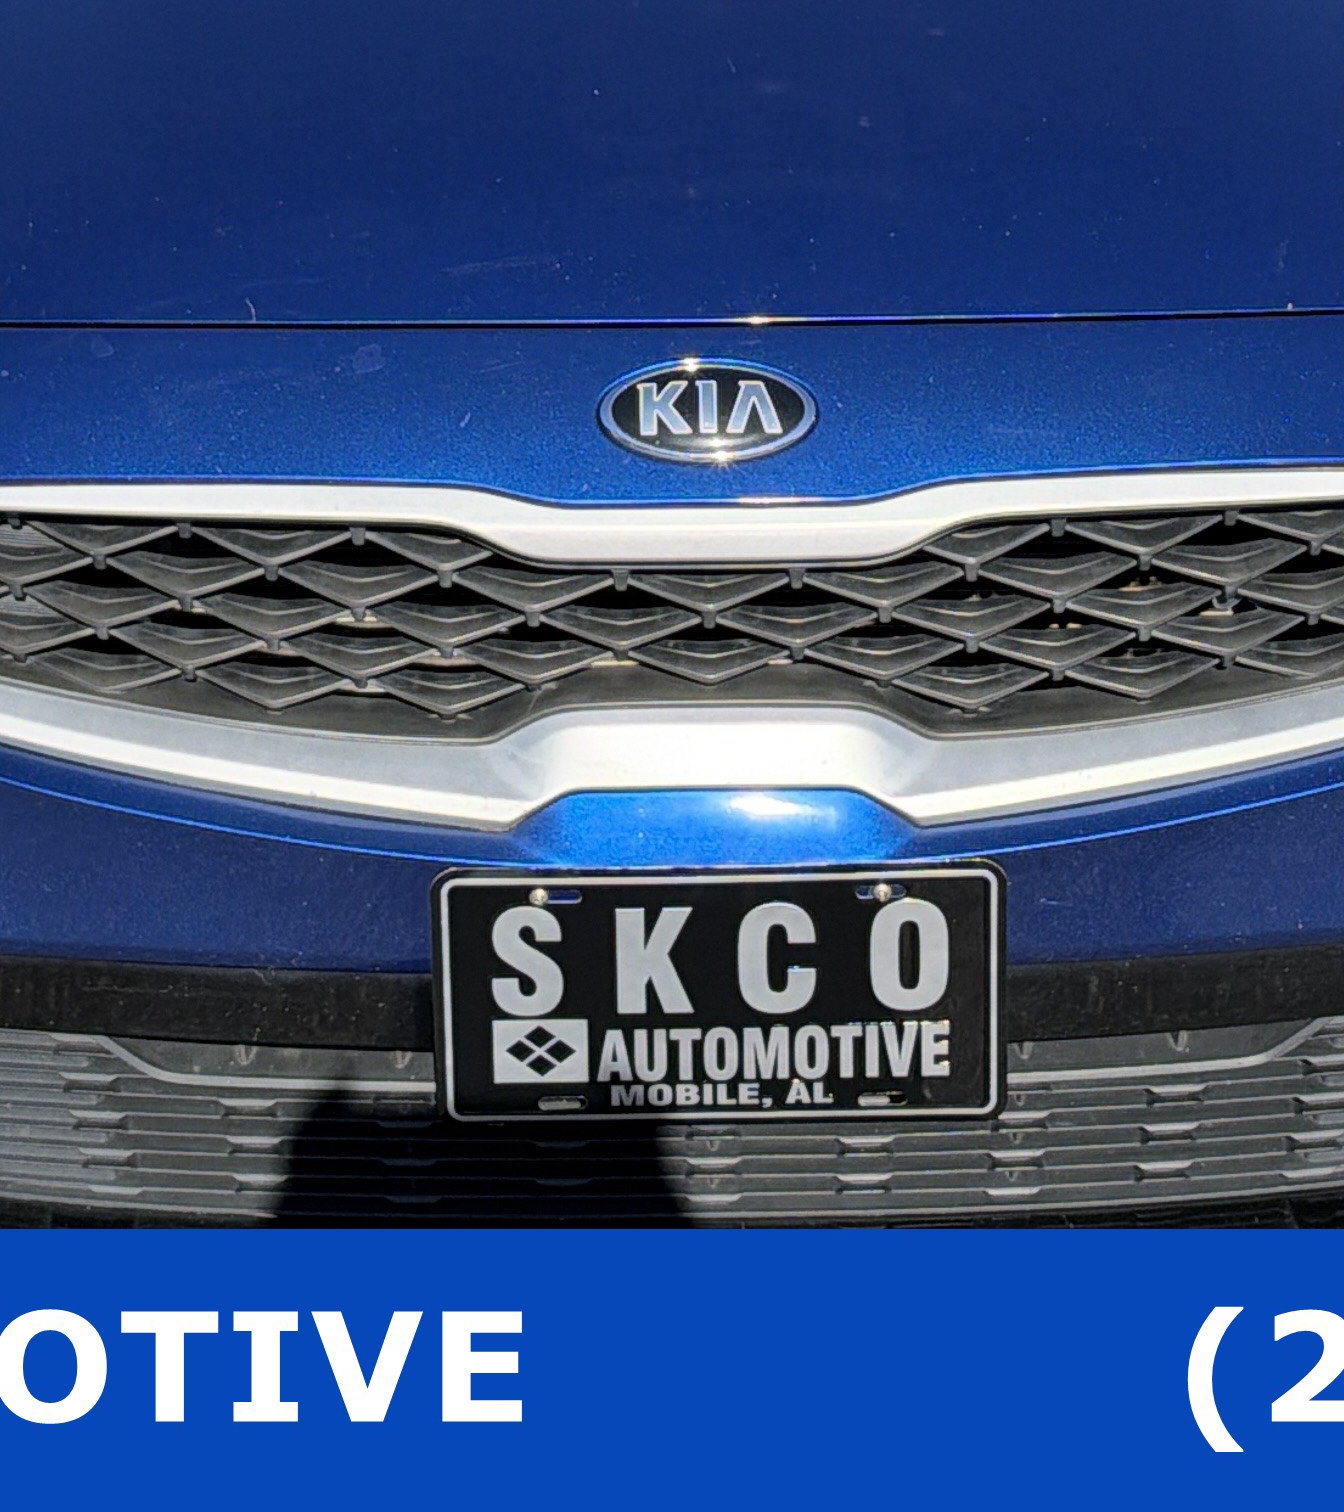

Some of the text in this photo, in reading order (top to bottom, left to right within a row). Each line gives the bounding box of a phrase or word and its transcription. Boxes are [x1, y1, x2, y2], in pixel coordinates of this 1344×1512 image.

[637, 380, 783, 436] KIA
[597, 1021, 950, 1082] AUTOMOTIVE
[610, 1081, 834, 1108] MOBILE, AL
